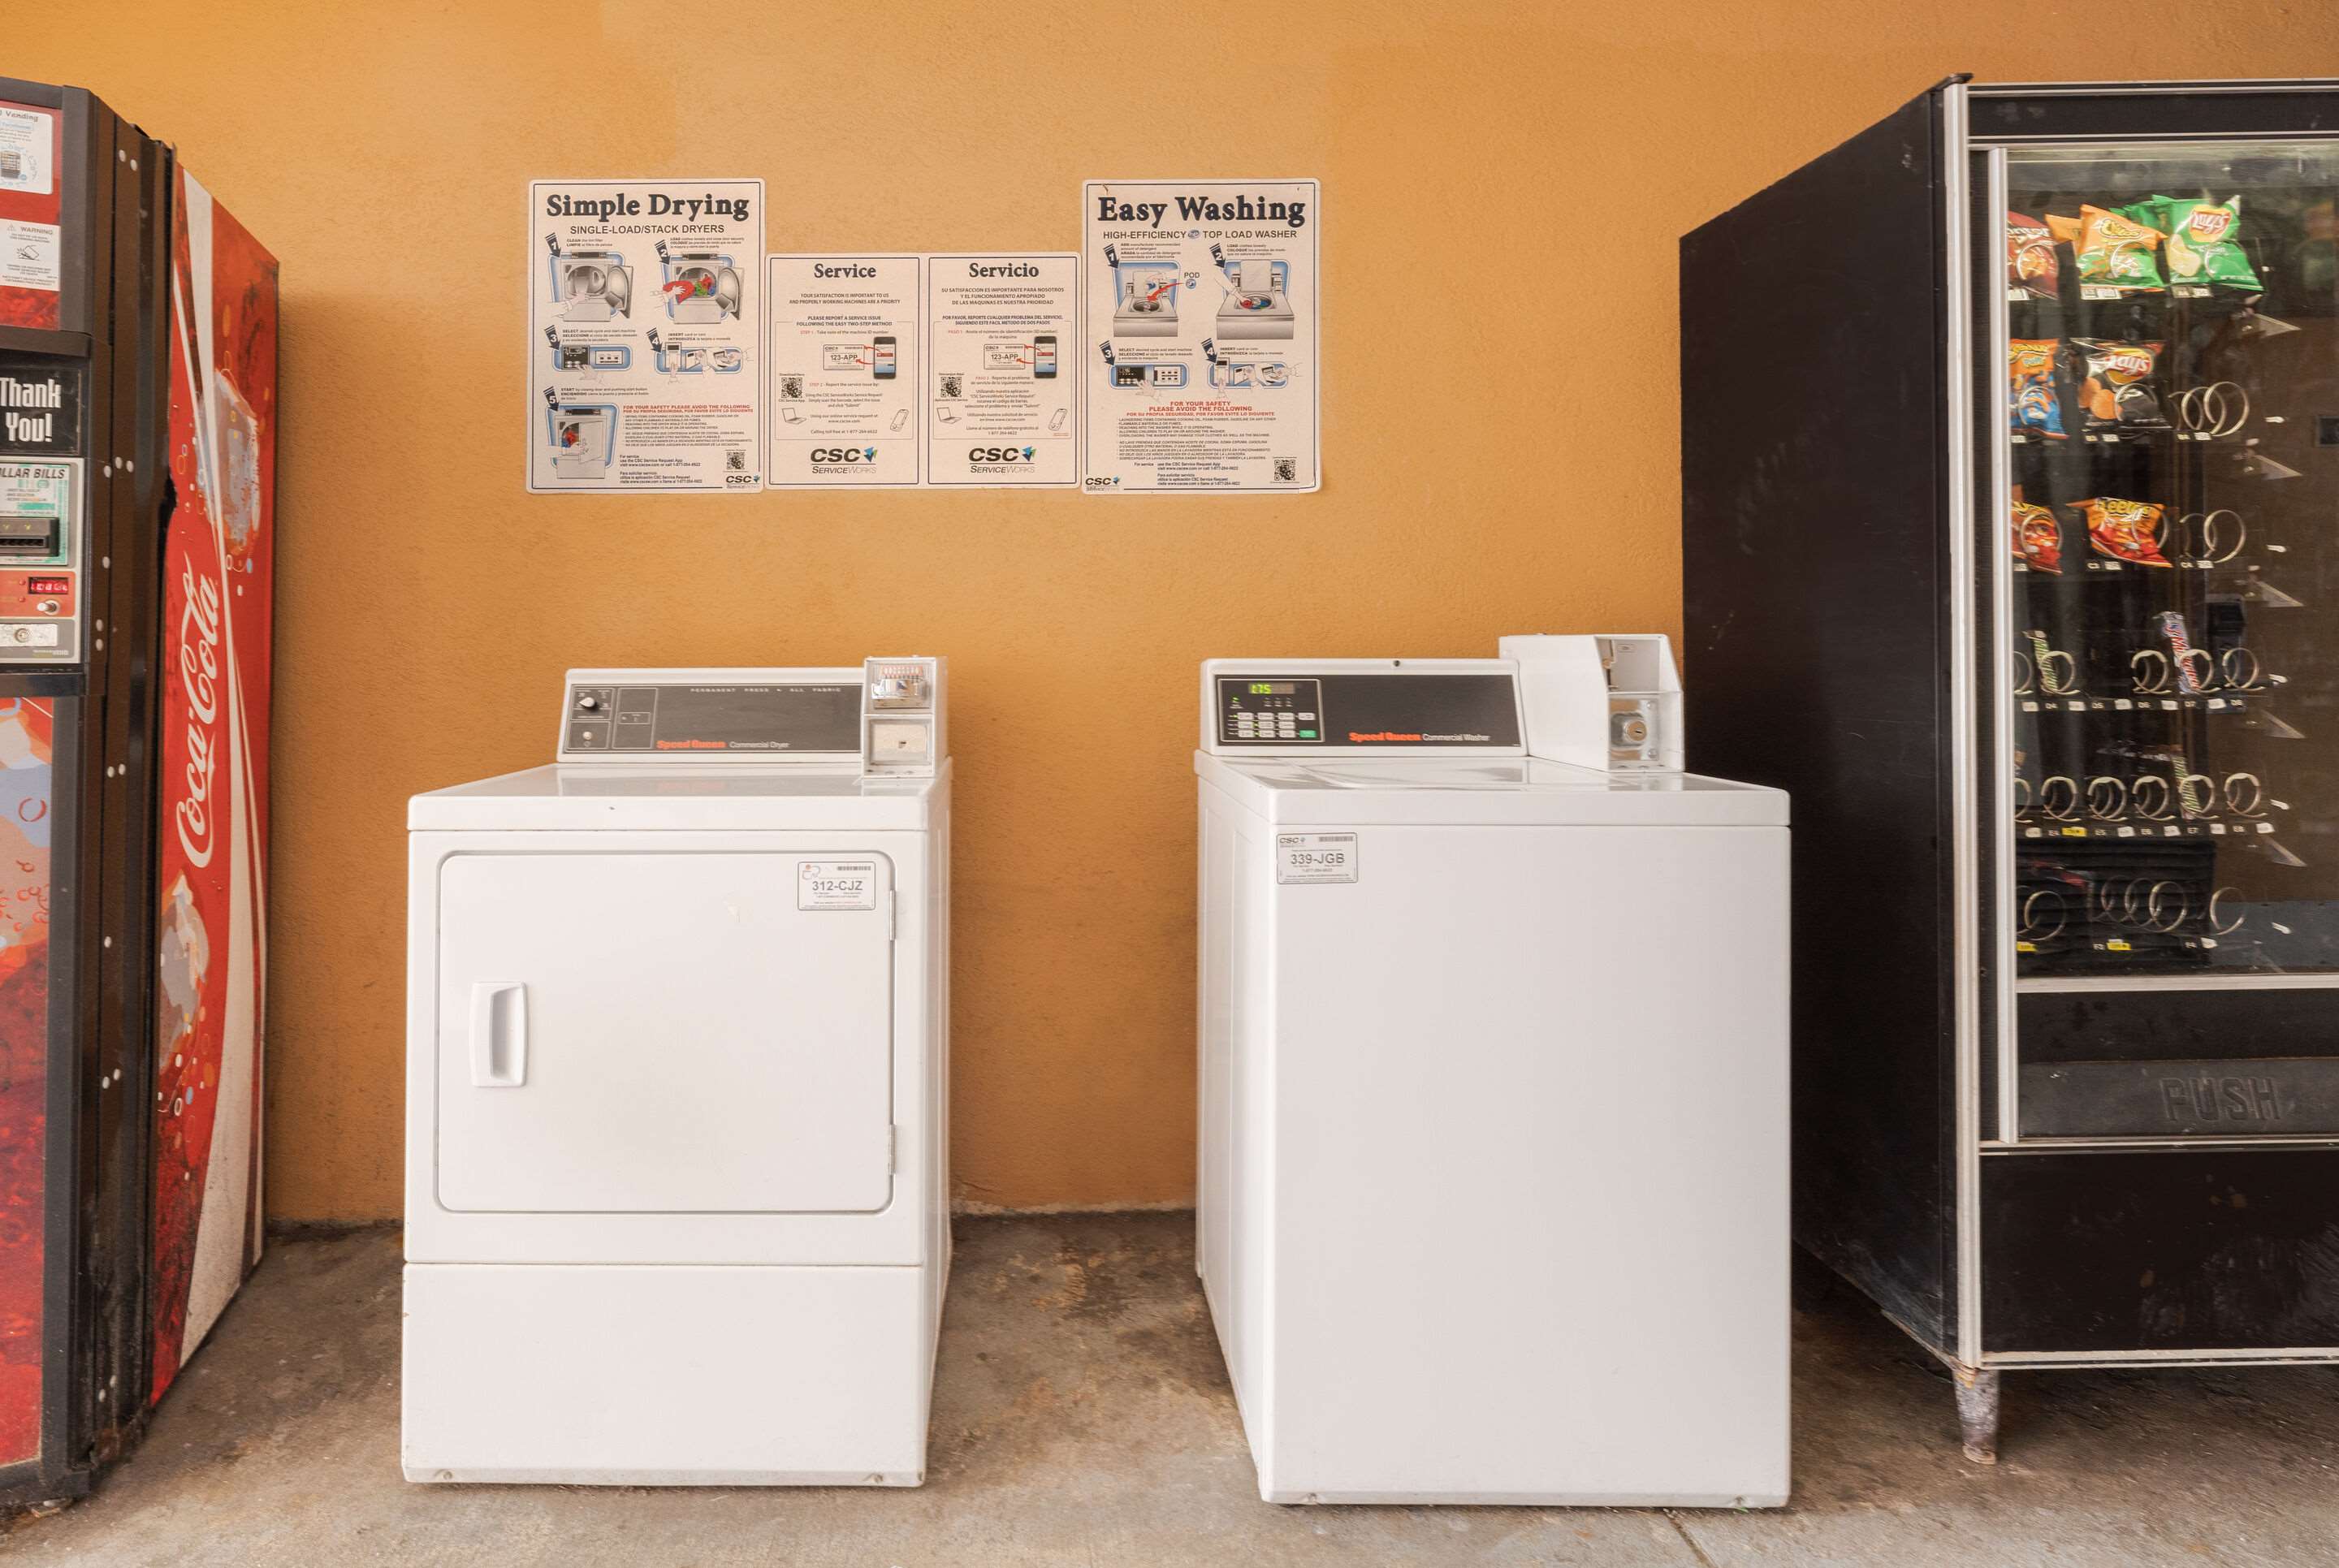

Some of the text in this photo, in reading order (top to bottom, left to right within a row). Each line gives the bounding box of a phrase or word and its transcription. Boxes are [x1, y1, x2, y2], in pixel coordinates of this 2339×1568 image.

[547, 193, 749, 222] Simple Drying
[1098, 195, 1306, 228] Easy Washing
[570, 225, 724, 234] SINGLE-LOAD/STACK DRYERS
[814, 263, 876, 278] Service
[969, 263, 1039, 277] Servicio
[2109, 355, 2150, 375] Lay's
[0, 378, 62, 408] Thank
[6, 413, 53, 443] You!
[810, 448, 860, 463] CSC
[969, 448, 1019, 462] CSC
[0, 468, 65, 479] LLAR BILLS
[175, 550, 220, 868] Coca-Cola
[657, 740, 690, 749] Speed
[691, 740, 727, 748] Queen
[1349, 732, 1385, 742] Speed
[1385, 732, 1422, 741] Queen
[1291, 853, 1345, 864] 339-JGB
[812, 880, 863, 891] 312-CJZ
[2159, 1077, 2281, 1122] PUSH
